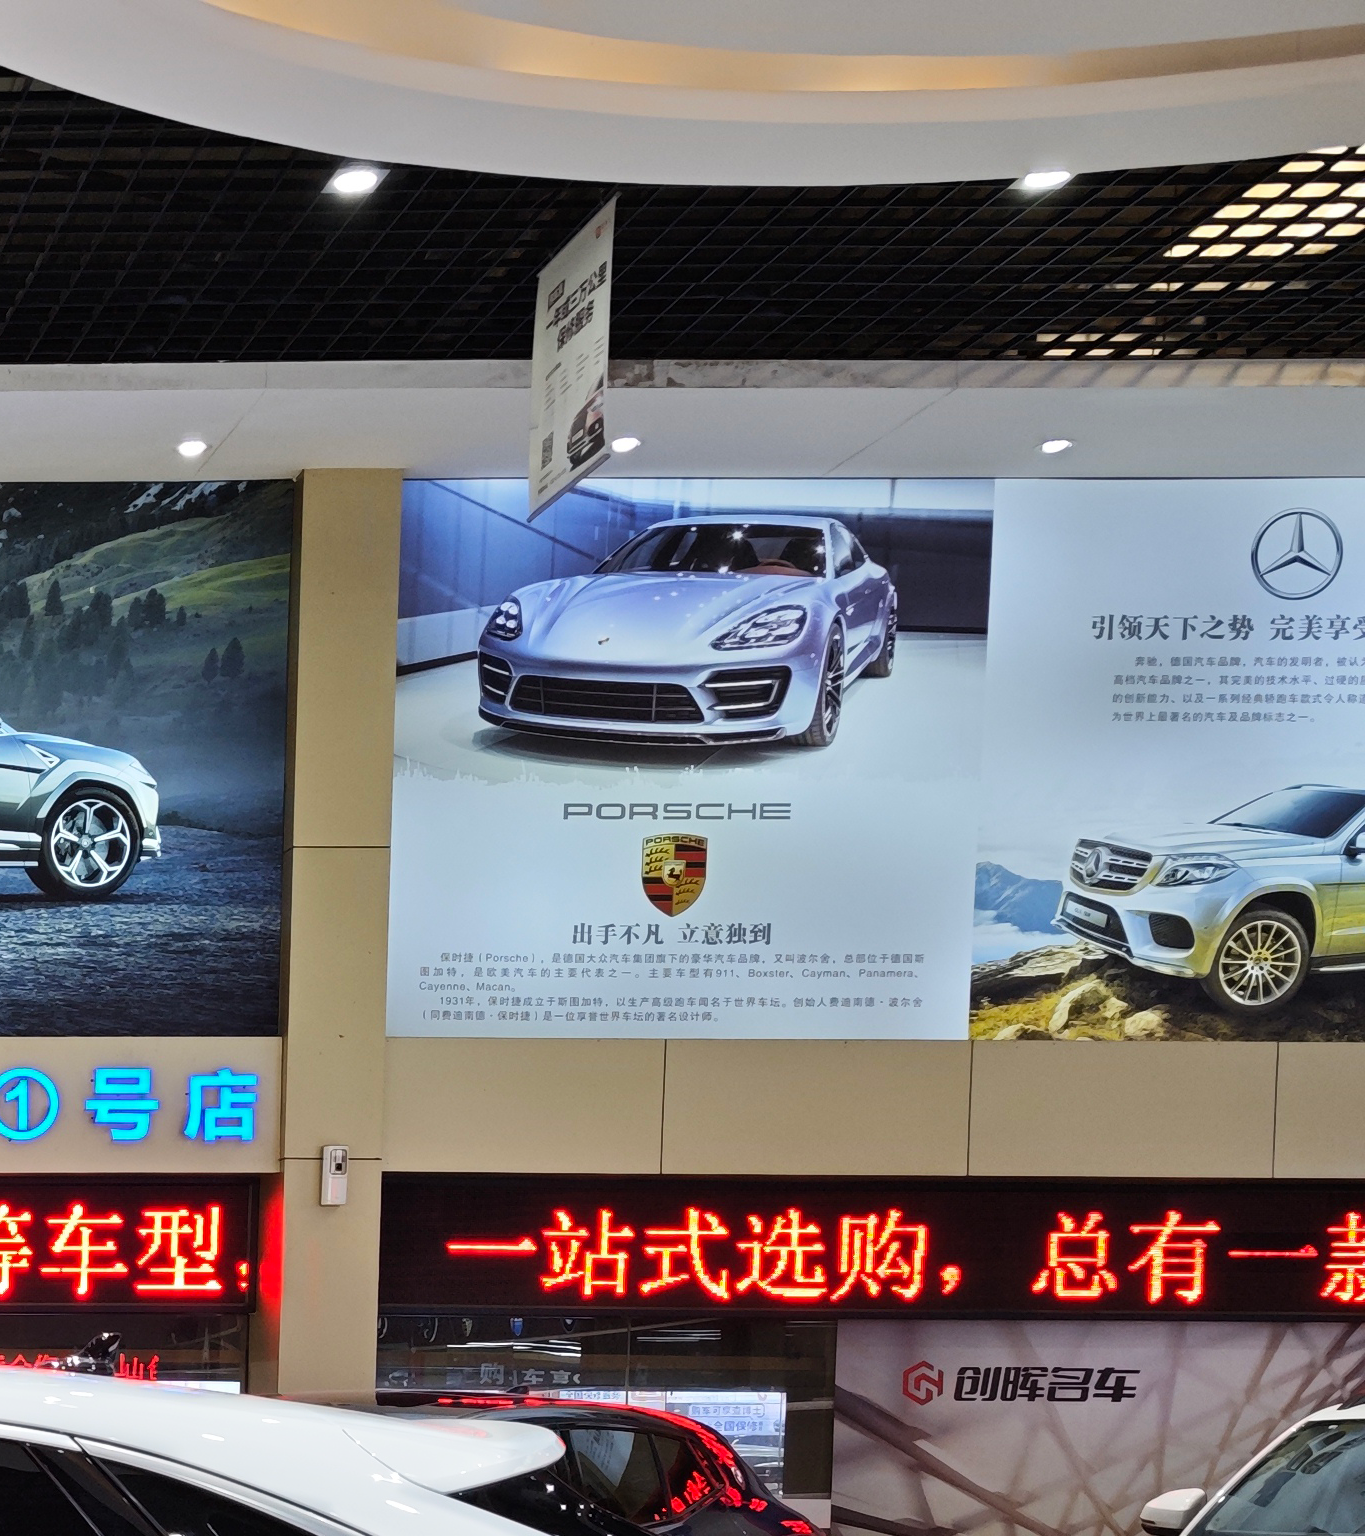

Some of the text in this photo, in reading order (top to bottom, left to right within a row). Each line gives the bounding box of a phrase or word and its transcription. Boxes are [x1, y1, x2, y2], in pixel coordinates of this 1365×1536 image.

[1091, 614, 1254, 640] 引领天下之势
[563, 803, 791, 820] PORSCHE
[645, 835, 705, 847] PORSCHE
[572, 923, 772, 945] 出手不凡 立意独到
[954, 1366, 1140, 1402] 创晖名车
